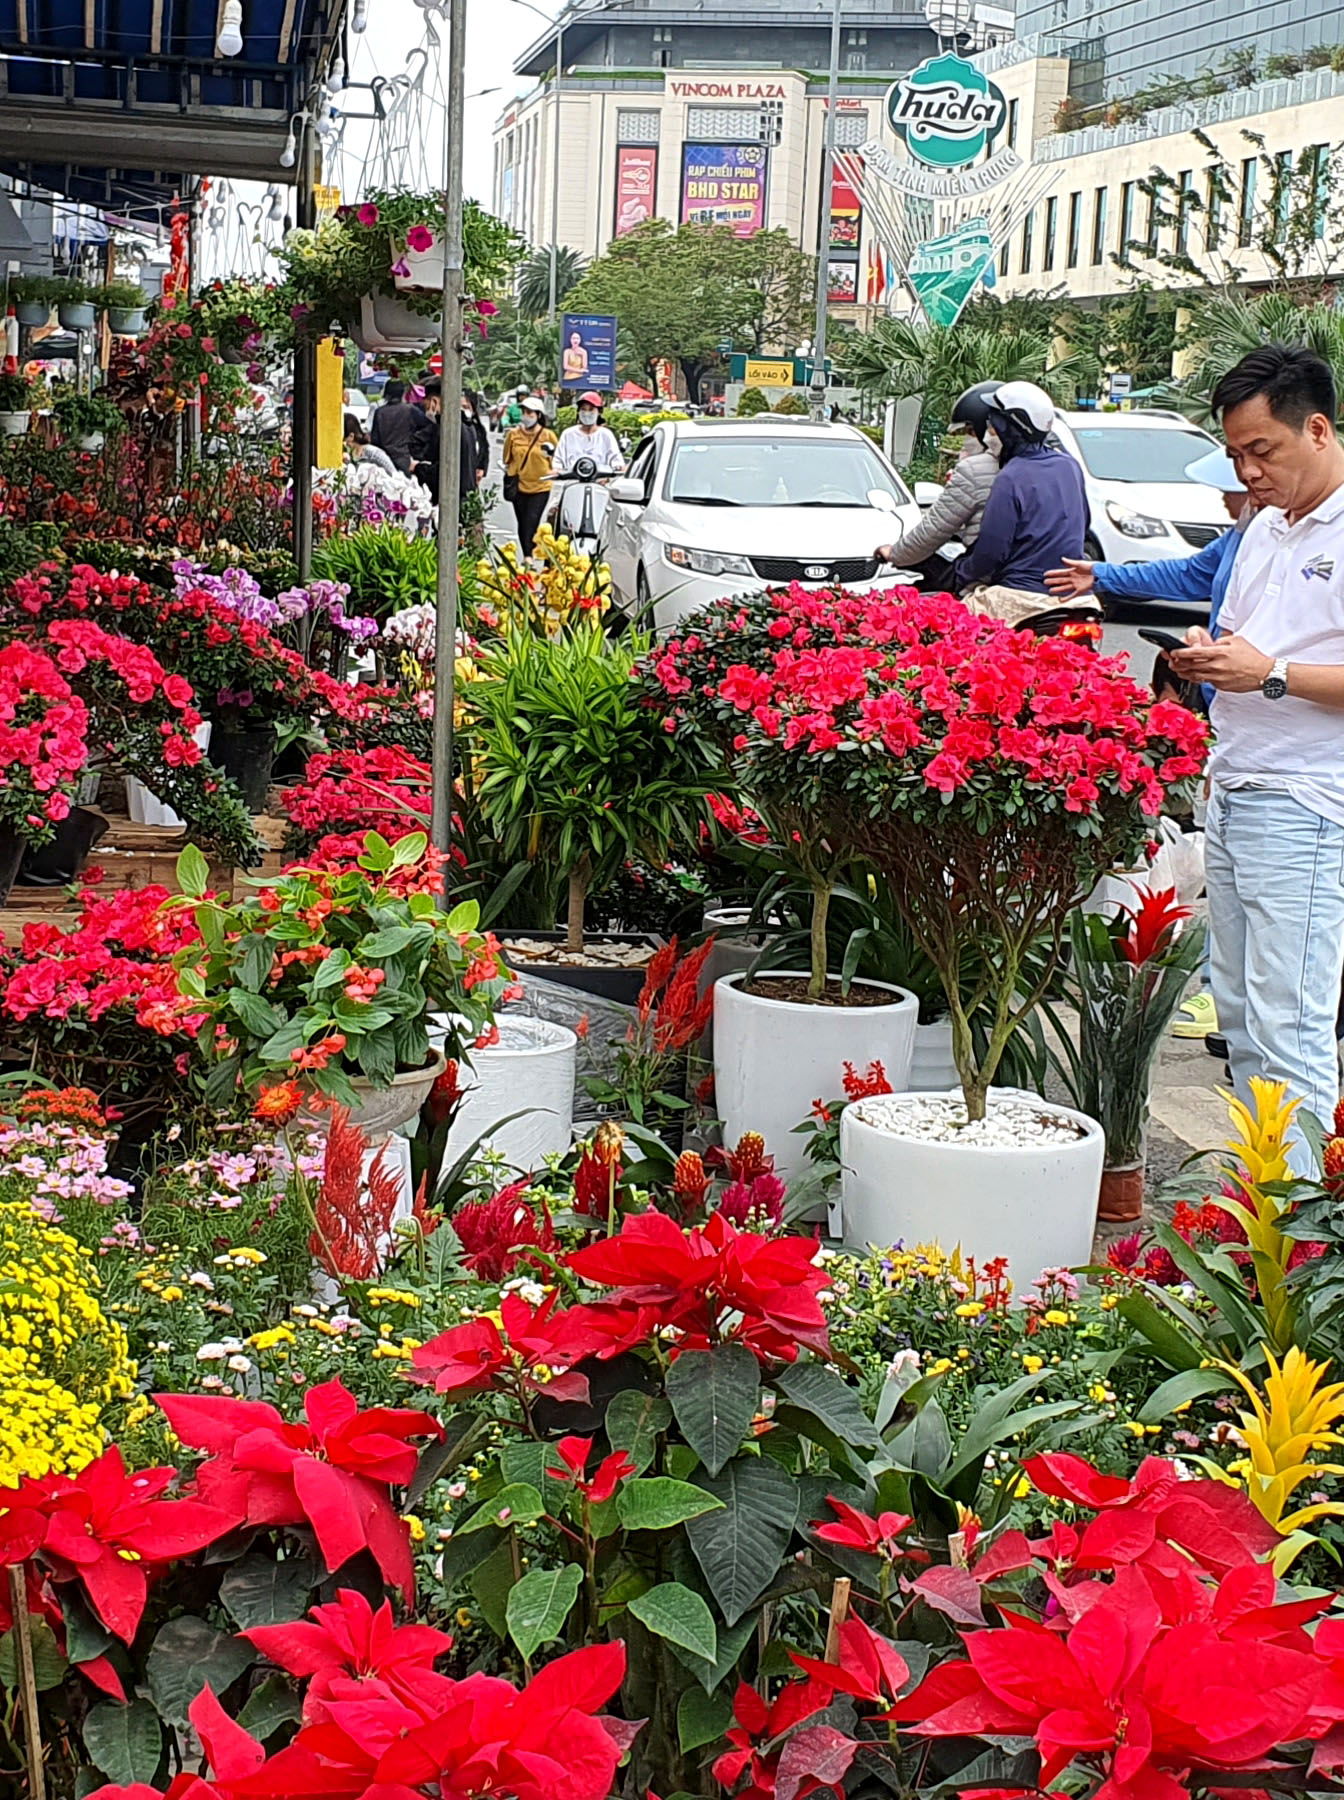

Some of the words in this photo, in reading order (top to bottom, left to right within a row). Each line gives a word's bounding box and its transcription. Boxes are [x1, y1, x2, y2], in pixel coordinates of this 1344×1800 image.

[670, 82, 733, 97] VINCOM
[737, 84, 786, 98] PLAZA
[898, 86, 997, 133] huda
[735, 166, 756, 178] PHIM
[969, 149, 1019, 191] TRUNG
[687, 181, 719, 198] BHD
[721, 182, 759, 200] STAR
